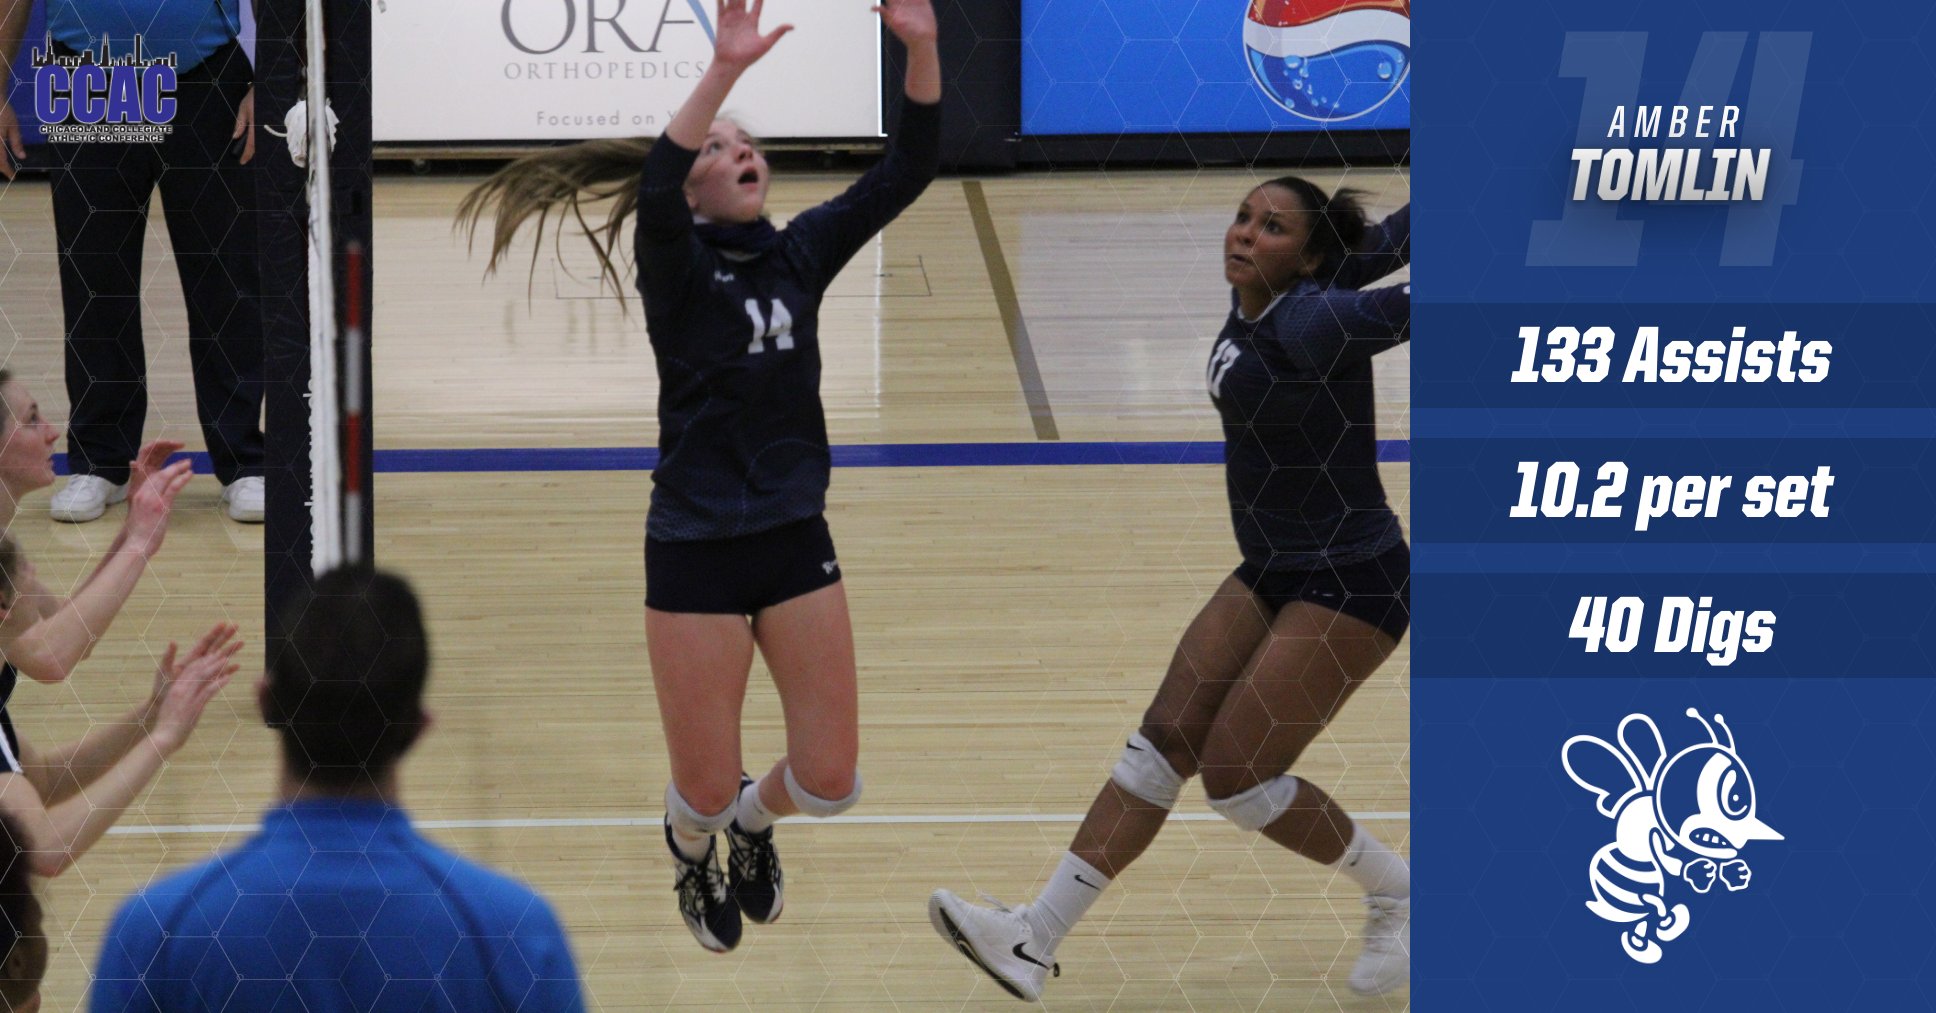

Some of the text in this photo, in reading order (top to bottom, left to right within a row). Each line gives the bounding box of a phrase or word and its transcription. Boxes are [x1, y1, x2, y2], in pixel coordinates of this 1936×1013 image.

[504, 61, 704, 80] ORTHOPEDICS
[536, 110, 620, 126] Focused
[631, 115, 655, 126] on
[745, 298, 794, 354] 14
